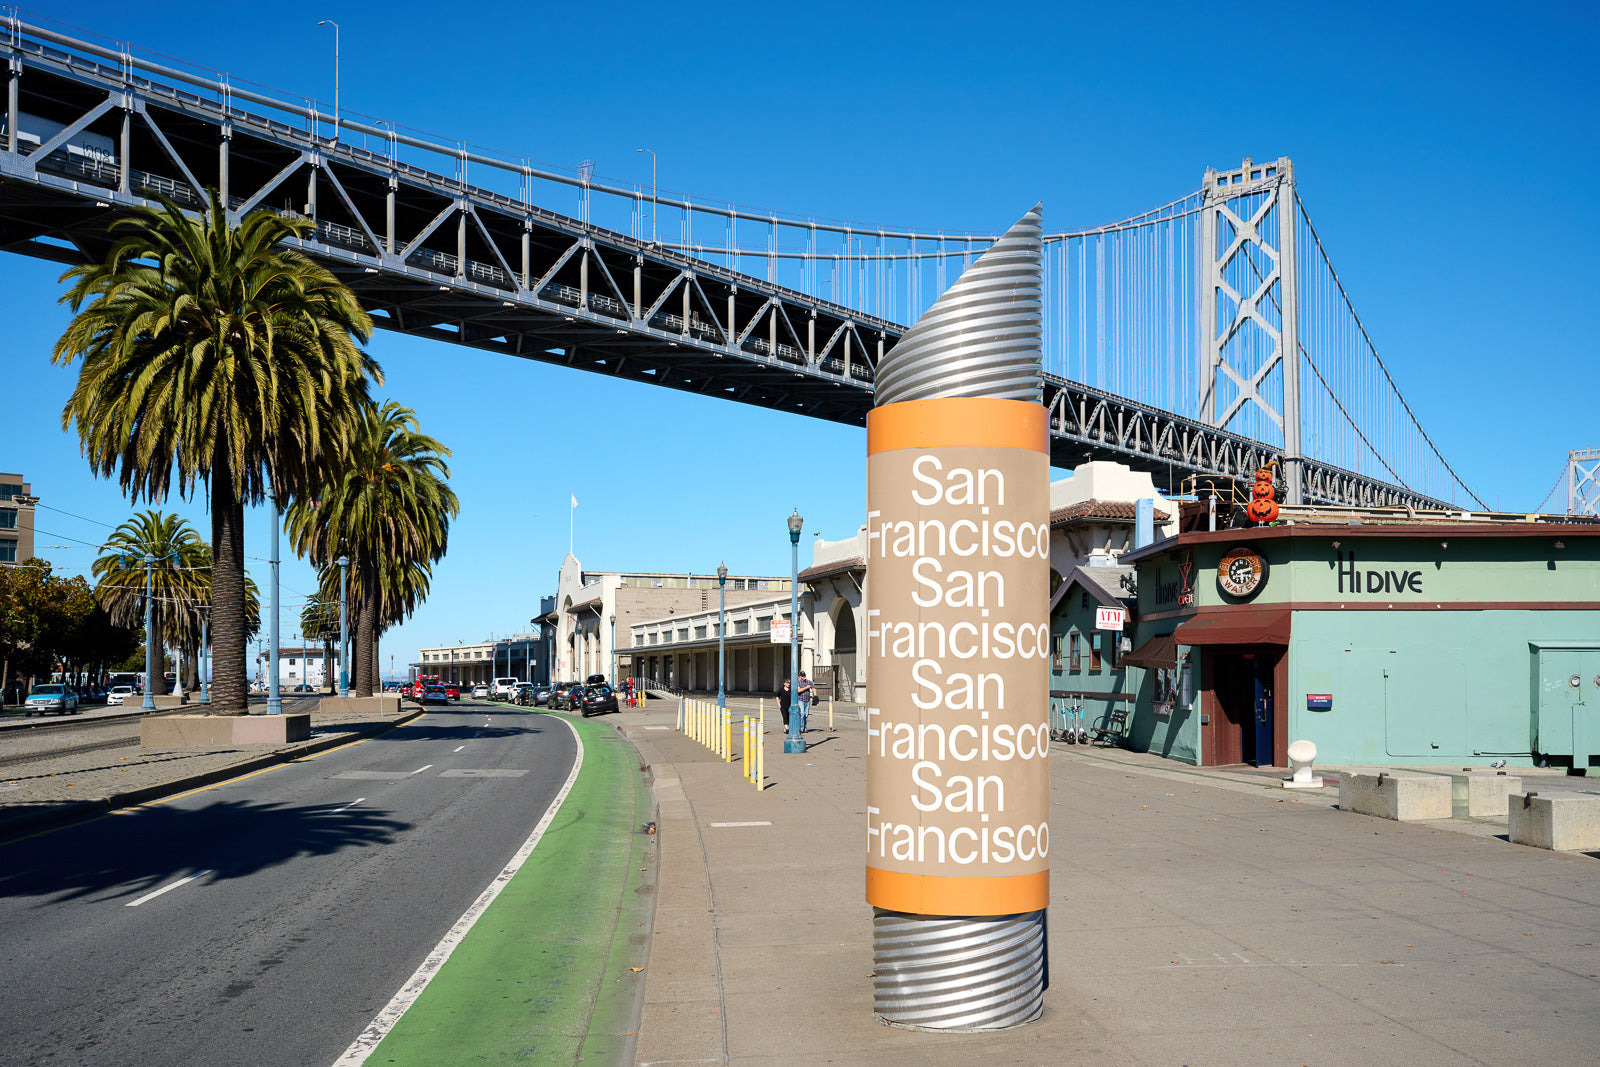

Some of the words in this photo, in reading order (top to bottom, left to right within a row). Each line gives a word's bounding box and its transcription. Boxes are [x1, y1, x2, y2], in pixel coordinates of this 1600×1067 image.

[911, 455, 1004, 506] San
[867, 506, 1049, 560] Francisco
[911, 557, 1004, 608] San
[1224, 577, 1257, 593] WATER
[1337, 550, 1361, 593] HI
[1366, 570, 1423, 593] DIVE
[867, 608, 1049, 659] Francisco
[1100, 610, 1121, 622] ATM
[911, 659, 1004, 710] San
[867, 707, 1049, 762] Francisco
[911, 761, 1004, 812] San
[867, 805, 1049, 865] Francisco
